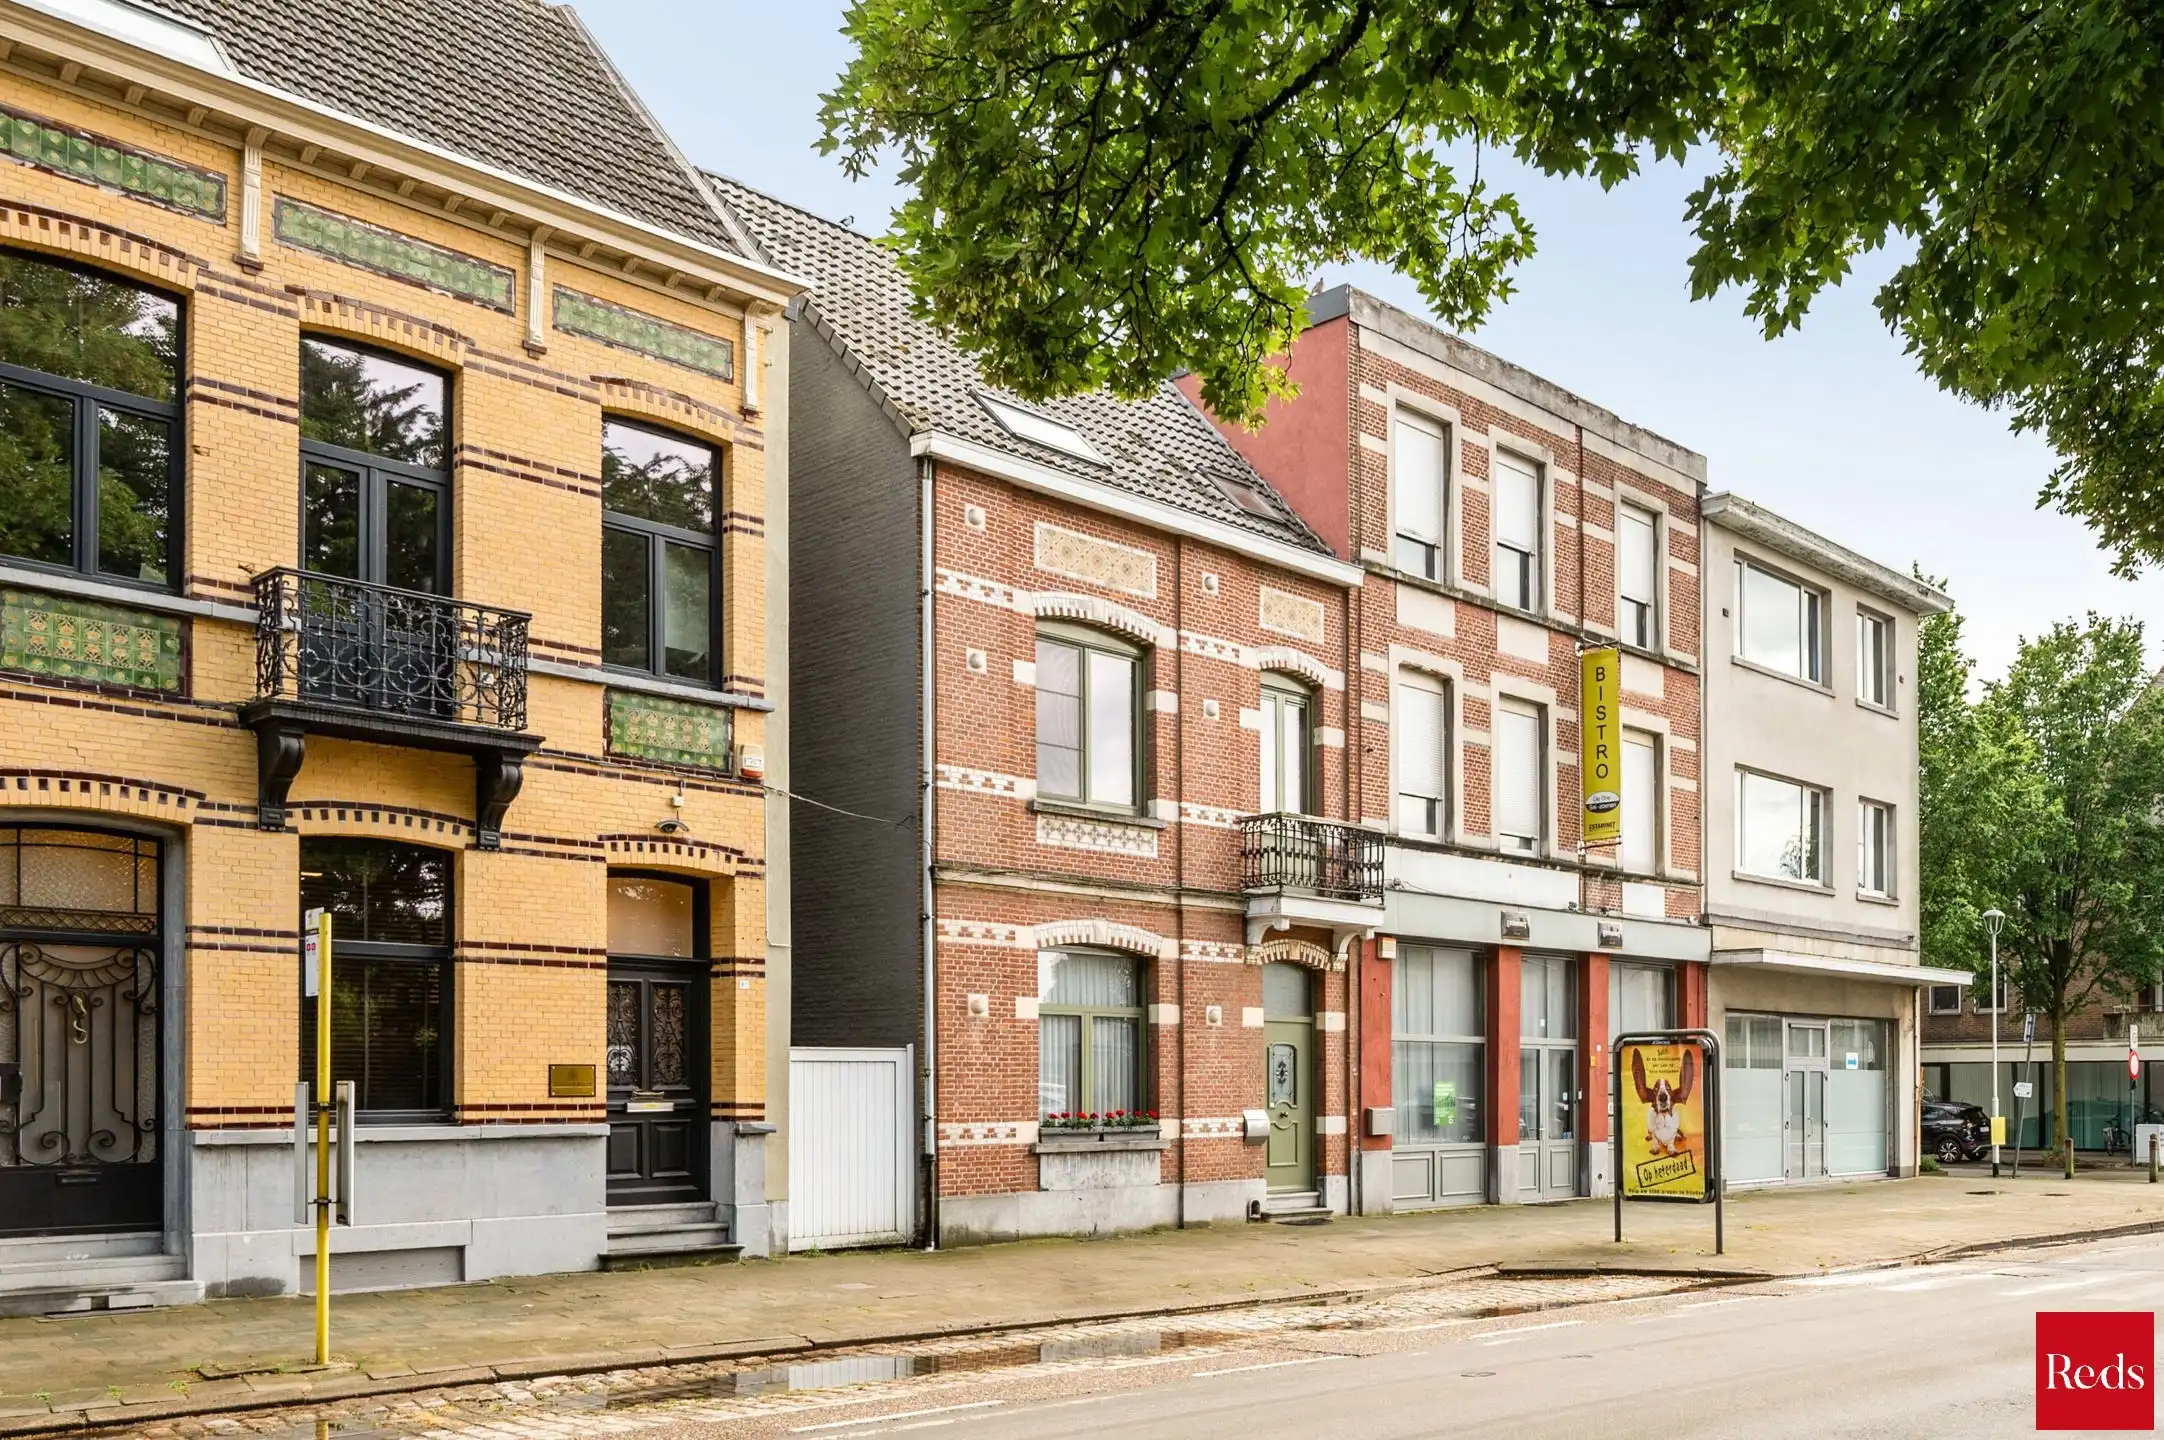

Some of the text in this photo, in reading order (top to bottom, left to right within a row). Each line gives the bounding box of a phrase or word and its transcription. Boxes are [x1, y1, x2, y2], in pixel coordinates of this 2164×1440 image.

[1595, 666, 1609, 779] BISTRO
[1643, 1155, 1688, 1182] Op heterdaad
